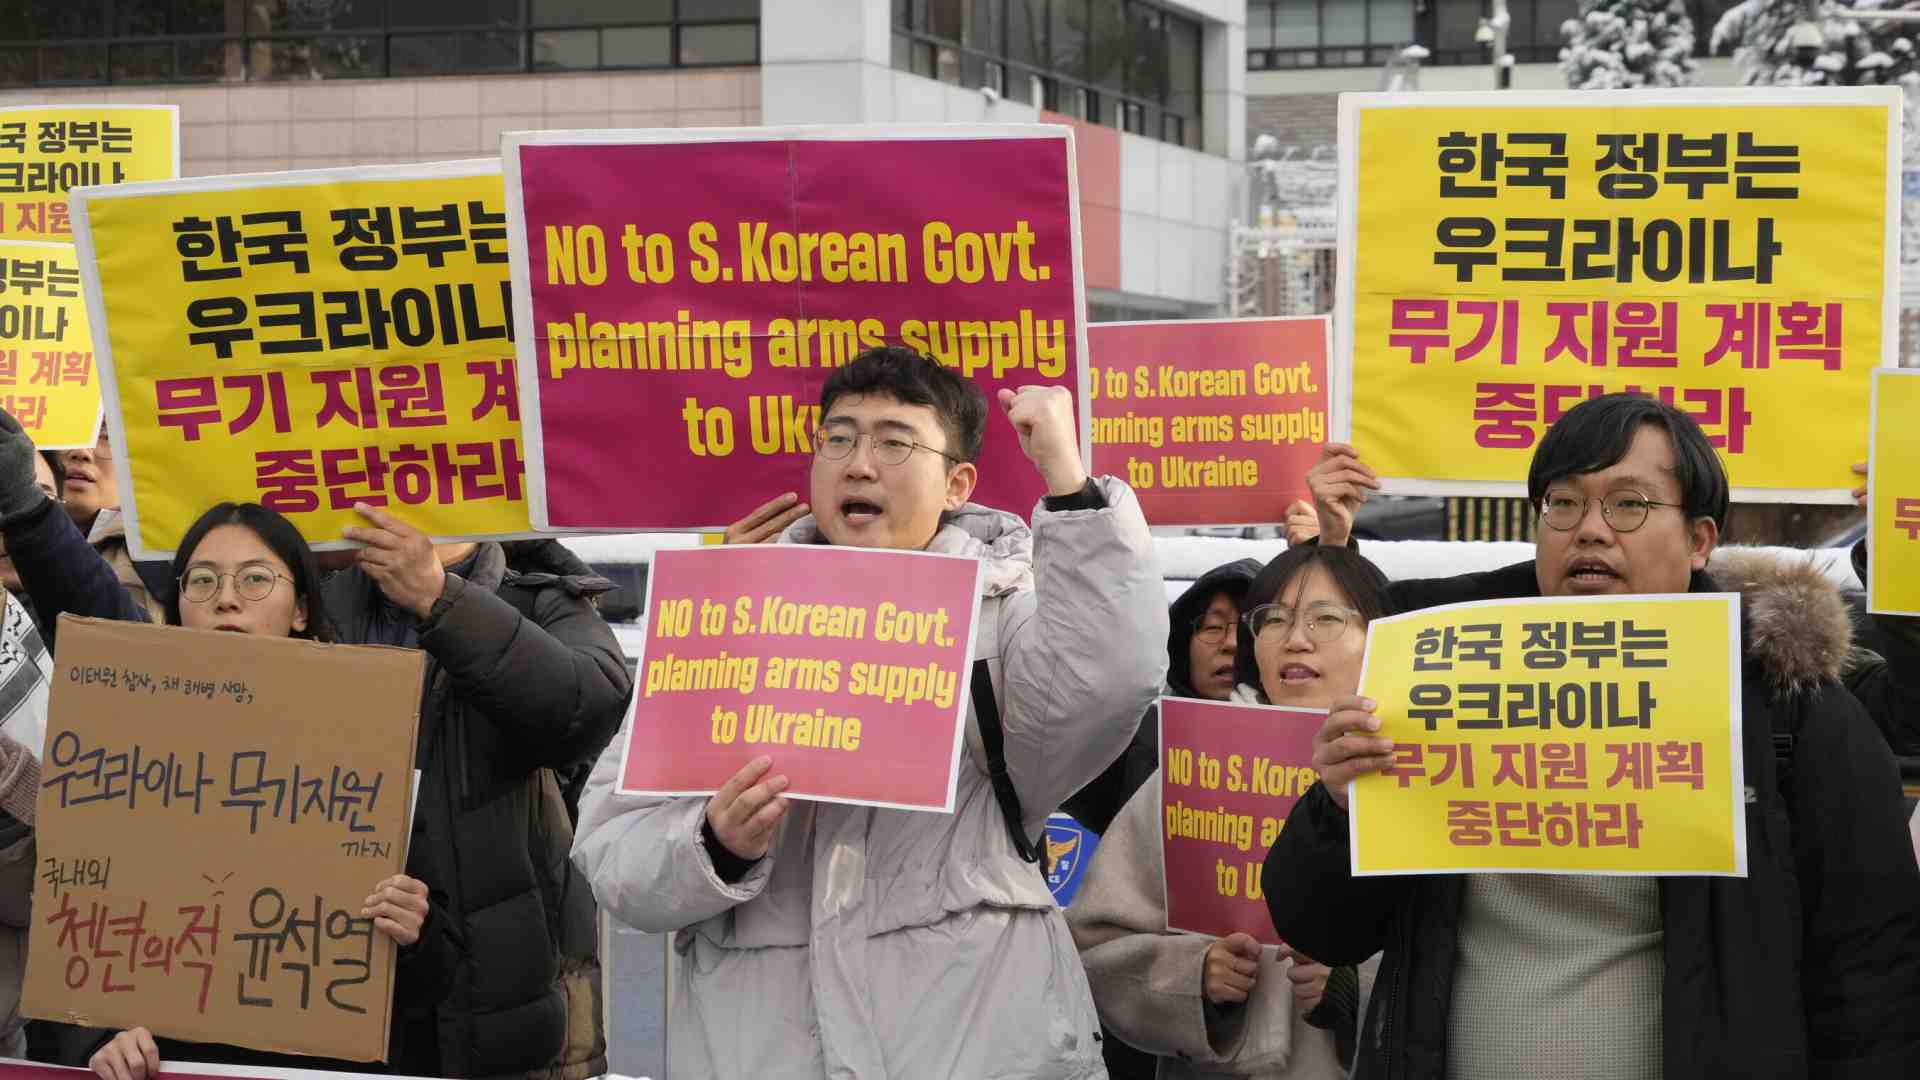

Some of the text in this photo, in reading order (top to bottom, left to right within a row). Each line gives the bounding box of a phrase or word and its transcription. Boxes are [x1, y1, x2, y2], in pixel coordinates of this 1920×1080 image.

[0, 121, 132, 154] 국 정부는
[0, 161, 125, 193] 크라이나
[1437, 131, 1801, 200] 한국 정부는
[172, 200, 510, 282] 한국 정부는
[544, 224, 607, 286] NO
[621, 224, 674, 284] to
[922, 220, 1050, 283] Govt.
[1433, 216, 1783, 284] 우크라이나
[186, 281, 516, 359] 우크라이나
[546, 309, 1066, 379] planning arms supply
[1388, 298, 1843, 371] 무기 지원 계획
[30, 351, 92, 386] 계획
[1105, 366, 1128, 398] to
[1254, 361, 1318, 396] Govt.
[155, 358, 520, 442] 무기 지원 계
[1473, 382, 1752, 454] 중라
[682, 397, 734, 456] to
[1090, 406, 1325, 448] anning arms supply
[255, 438, 525, 513] 중단하라
[1127, 455, 1258, 488] to Ukraine
[656, 598, 694, 638] NO
[700, 598, 727, 635] to
[875, 601, 955, 647] Govt.
[1412, 620, 1669, 672] 한국 정부는
[70, 666, 117, 688] 이태원
[644, 650, 957, 709] planning arms supply
[711, 704, 862, 751] to Ukraine
[1407, 681, 1657, 731] 우크라이나
[43, 731, 383, 834] 우크라이나 무기지원
[1167, 747, 1193, 786] NO
[1198, 751, 1221, 789] to
[1380, 741, 1705, 790] 무기 지원 계획
[341, 841, 390, 859] 까지
[1165, 800, 1254, 852] planning
[1446, 800, 1644, 849] 중단하라
[42, 856, 110, 897] 국내외
[1215, 857, 1239, 897] to
[233, 887, 375, 1014] 윤석열
